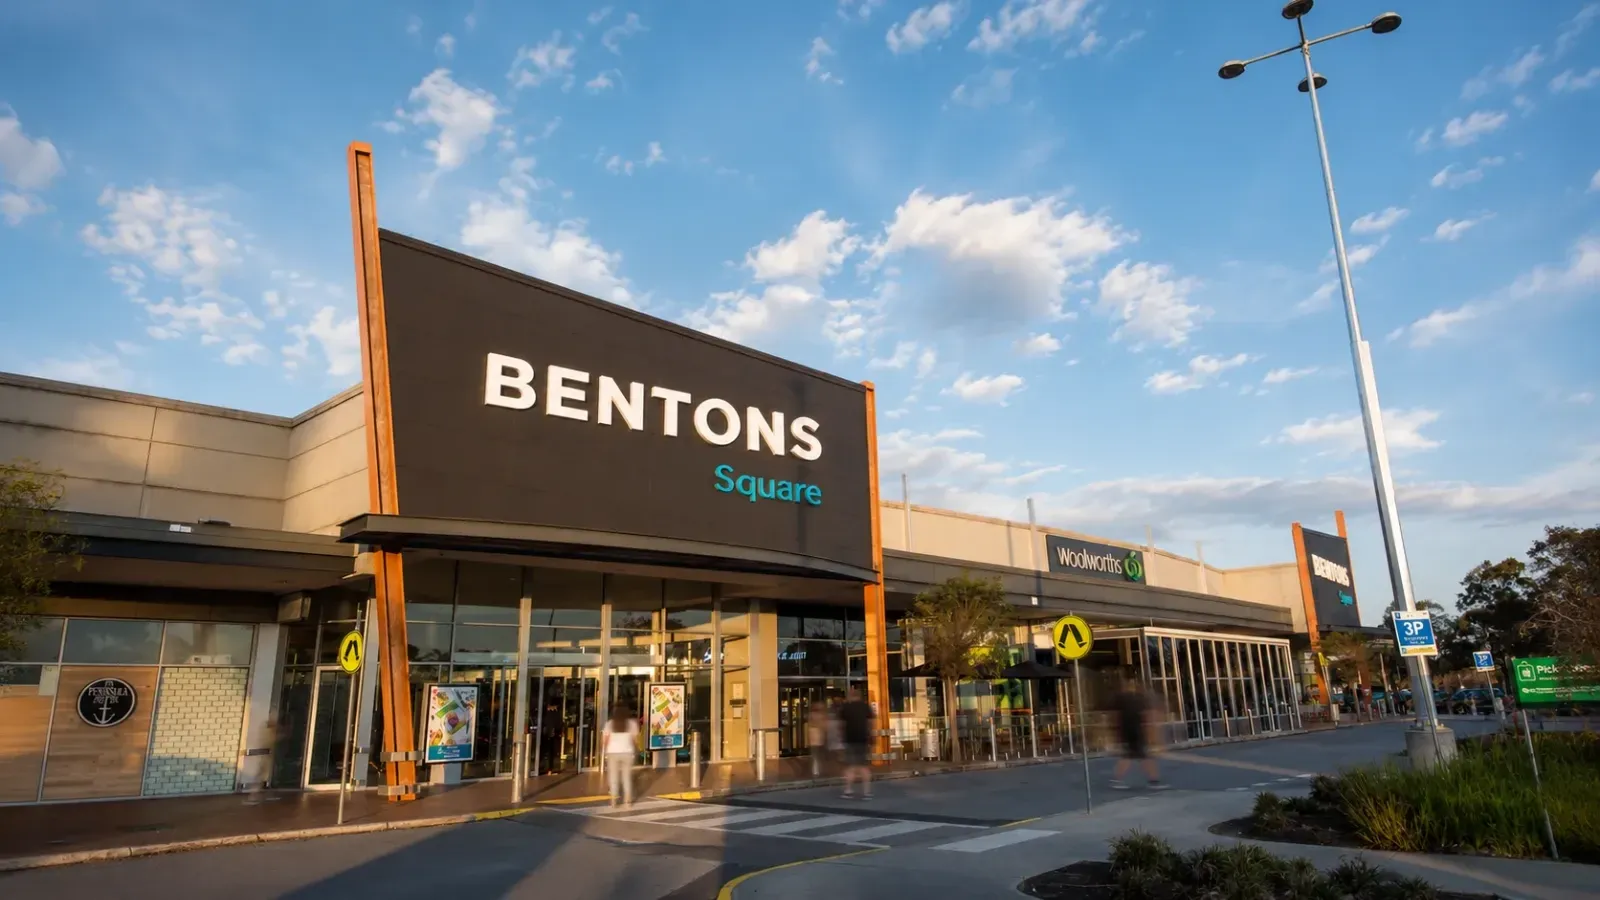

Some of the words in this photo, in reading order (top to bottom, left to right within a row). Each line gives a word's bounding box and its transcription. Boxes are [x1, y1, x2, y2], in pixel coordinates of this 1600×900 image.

[484, 352, 822, 461] BENTONS
[714, 464, 822, 506] Square
[1057, 546, 1122, 574] Woolworths
[1404, 621, 1424, 635] 3P
[1536, 664, 1559, 674] Pick
